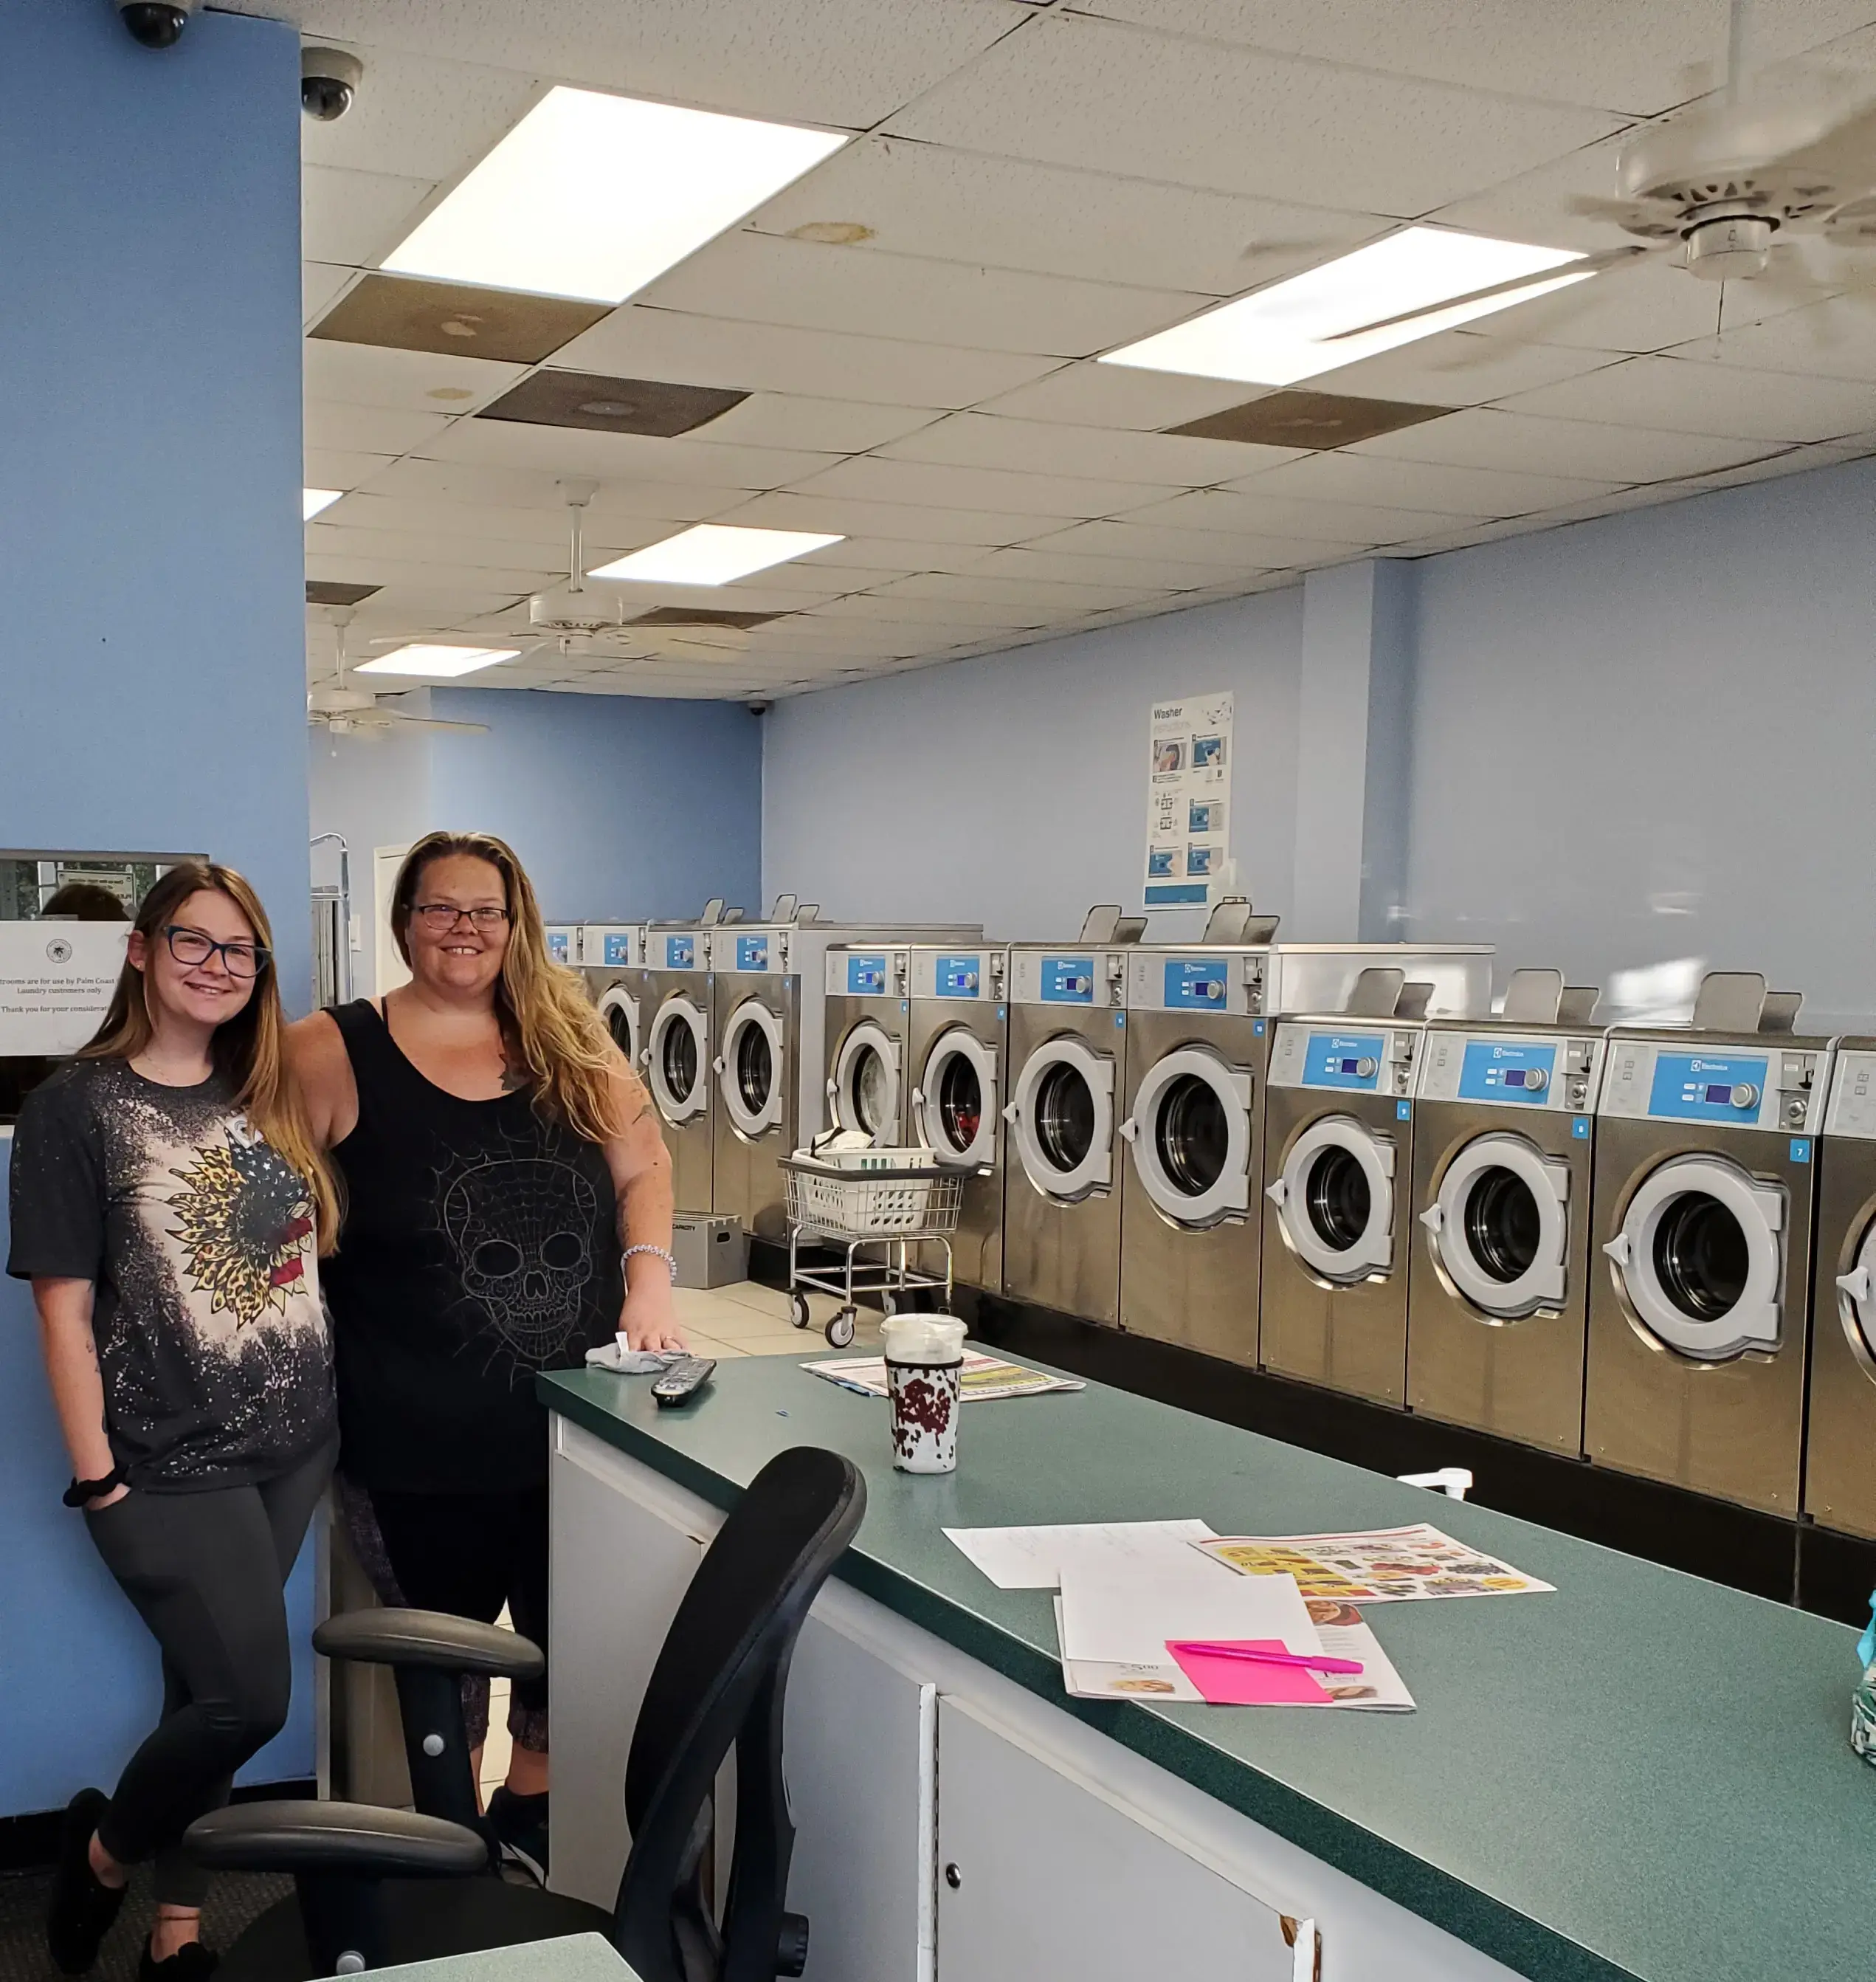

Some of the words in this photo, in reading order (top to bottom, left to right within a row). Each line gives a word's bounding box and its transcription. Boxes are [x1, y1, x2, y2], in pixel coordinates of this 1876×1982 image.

[1154, 708, 1183, 720] Washer
[66, 977, 75, 986] by
[17, 987, 46, 995] Laundry
[1797, 1148, 1803, 1157] 7
